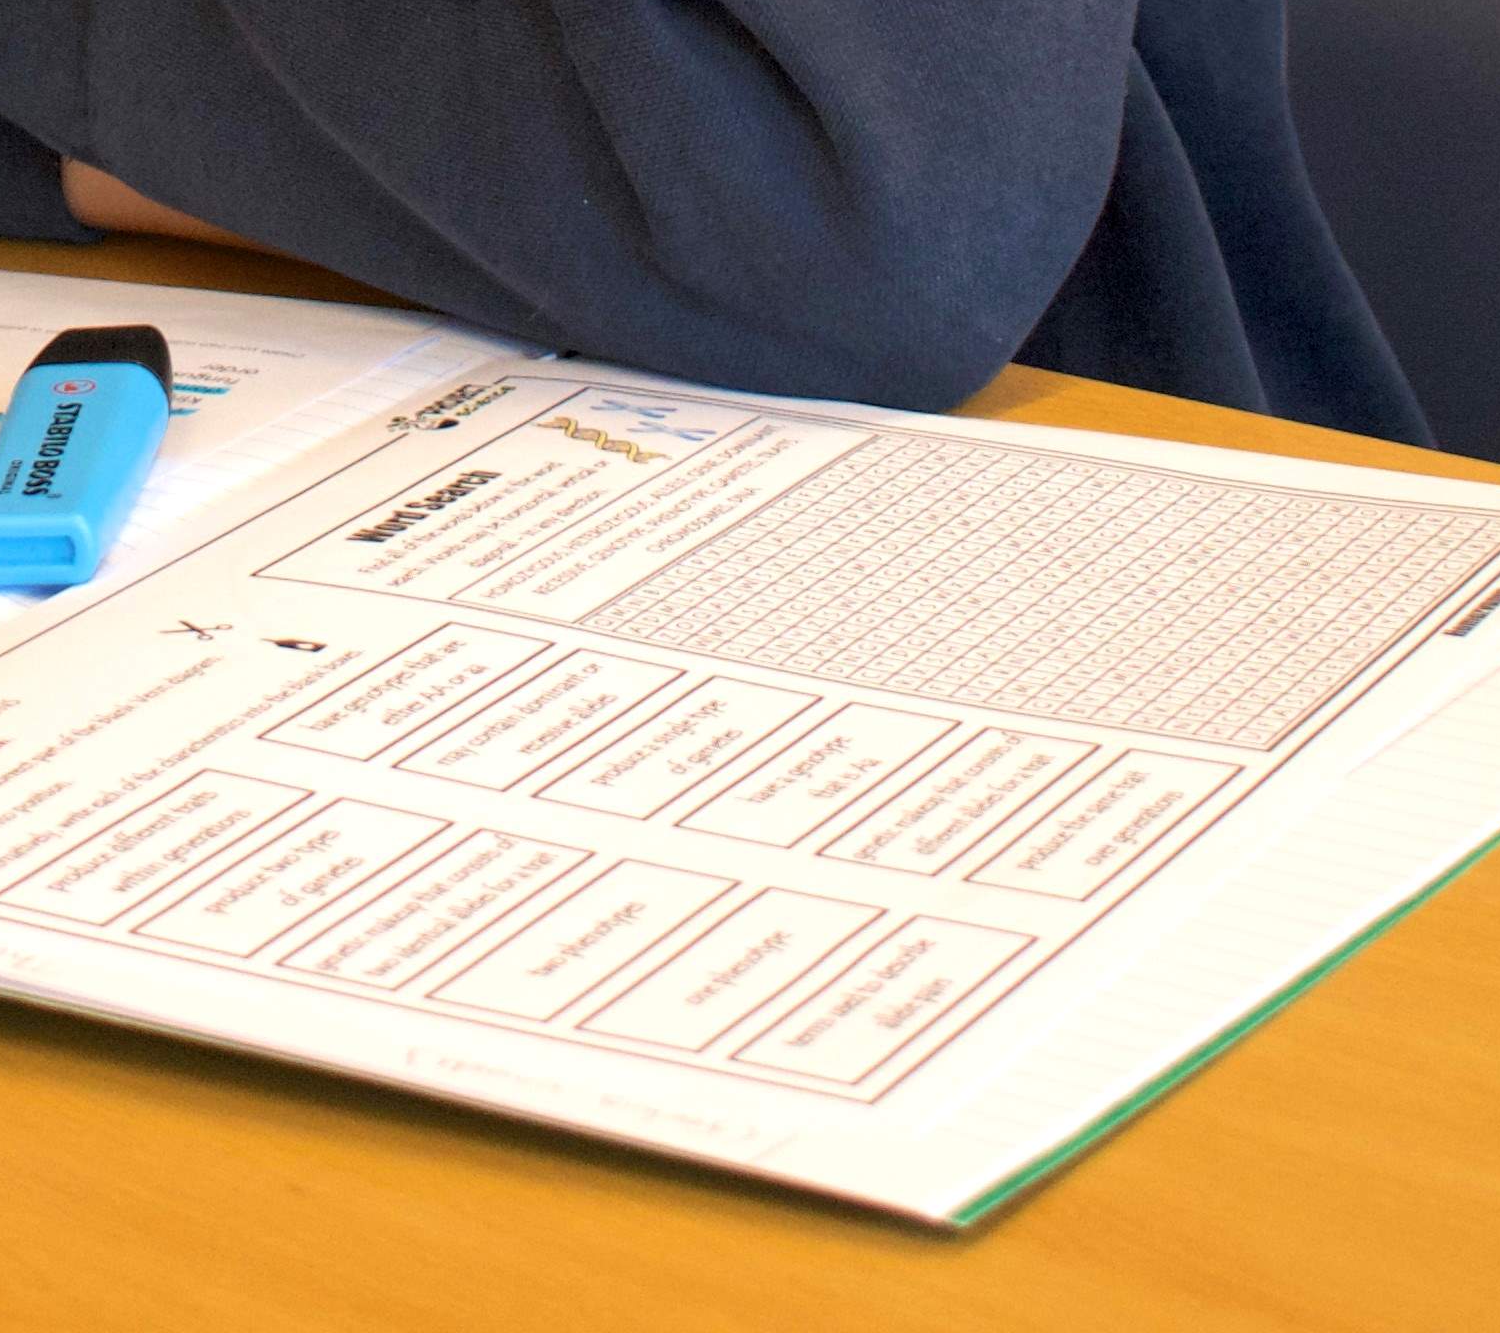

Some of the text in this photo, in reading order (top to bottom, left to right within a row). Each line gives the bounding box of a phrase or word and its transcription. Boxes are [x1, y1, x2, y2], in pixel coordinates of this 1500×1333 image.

[22, 402, 83, 496] STABILO BOSS
[346, 470, 500, 543] Word Search
